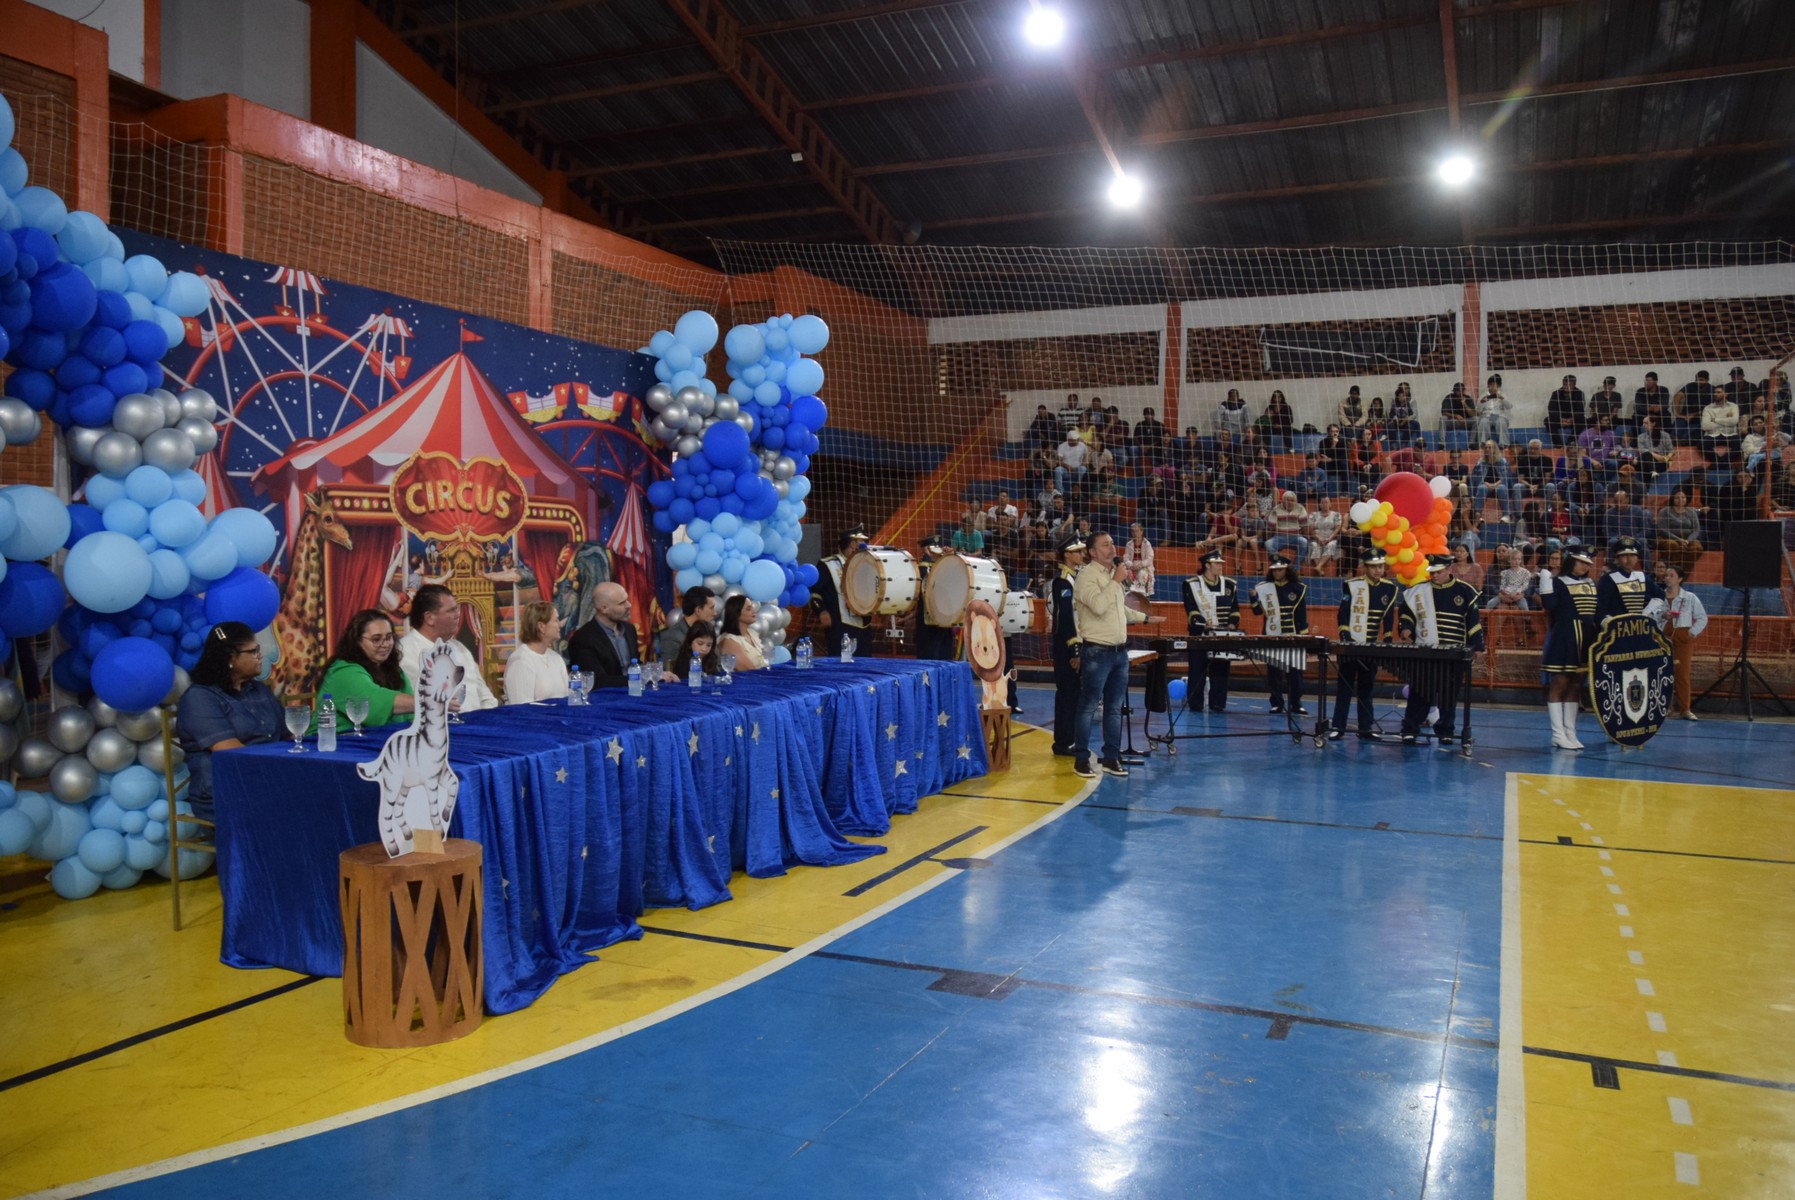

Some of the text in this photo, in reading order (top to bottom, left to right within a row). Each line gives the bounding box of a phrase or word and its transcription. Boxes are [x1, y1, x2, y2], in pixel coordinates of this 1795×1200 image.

[405, 479, 511, 519] CIRCUS
[1266, 593, 1277, 631] FAMIG
[1353, 588, 1365, 633] FAMIG
[1415, 594, 1429, 638] FAMIG
[1617, 619, 1650, 638] FAMIG
